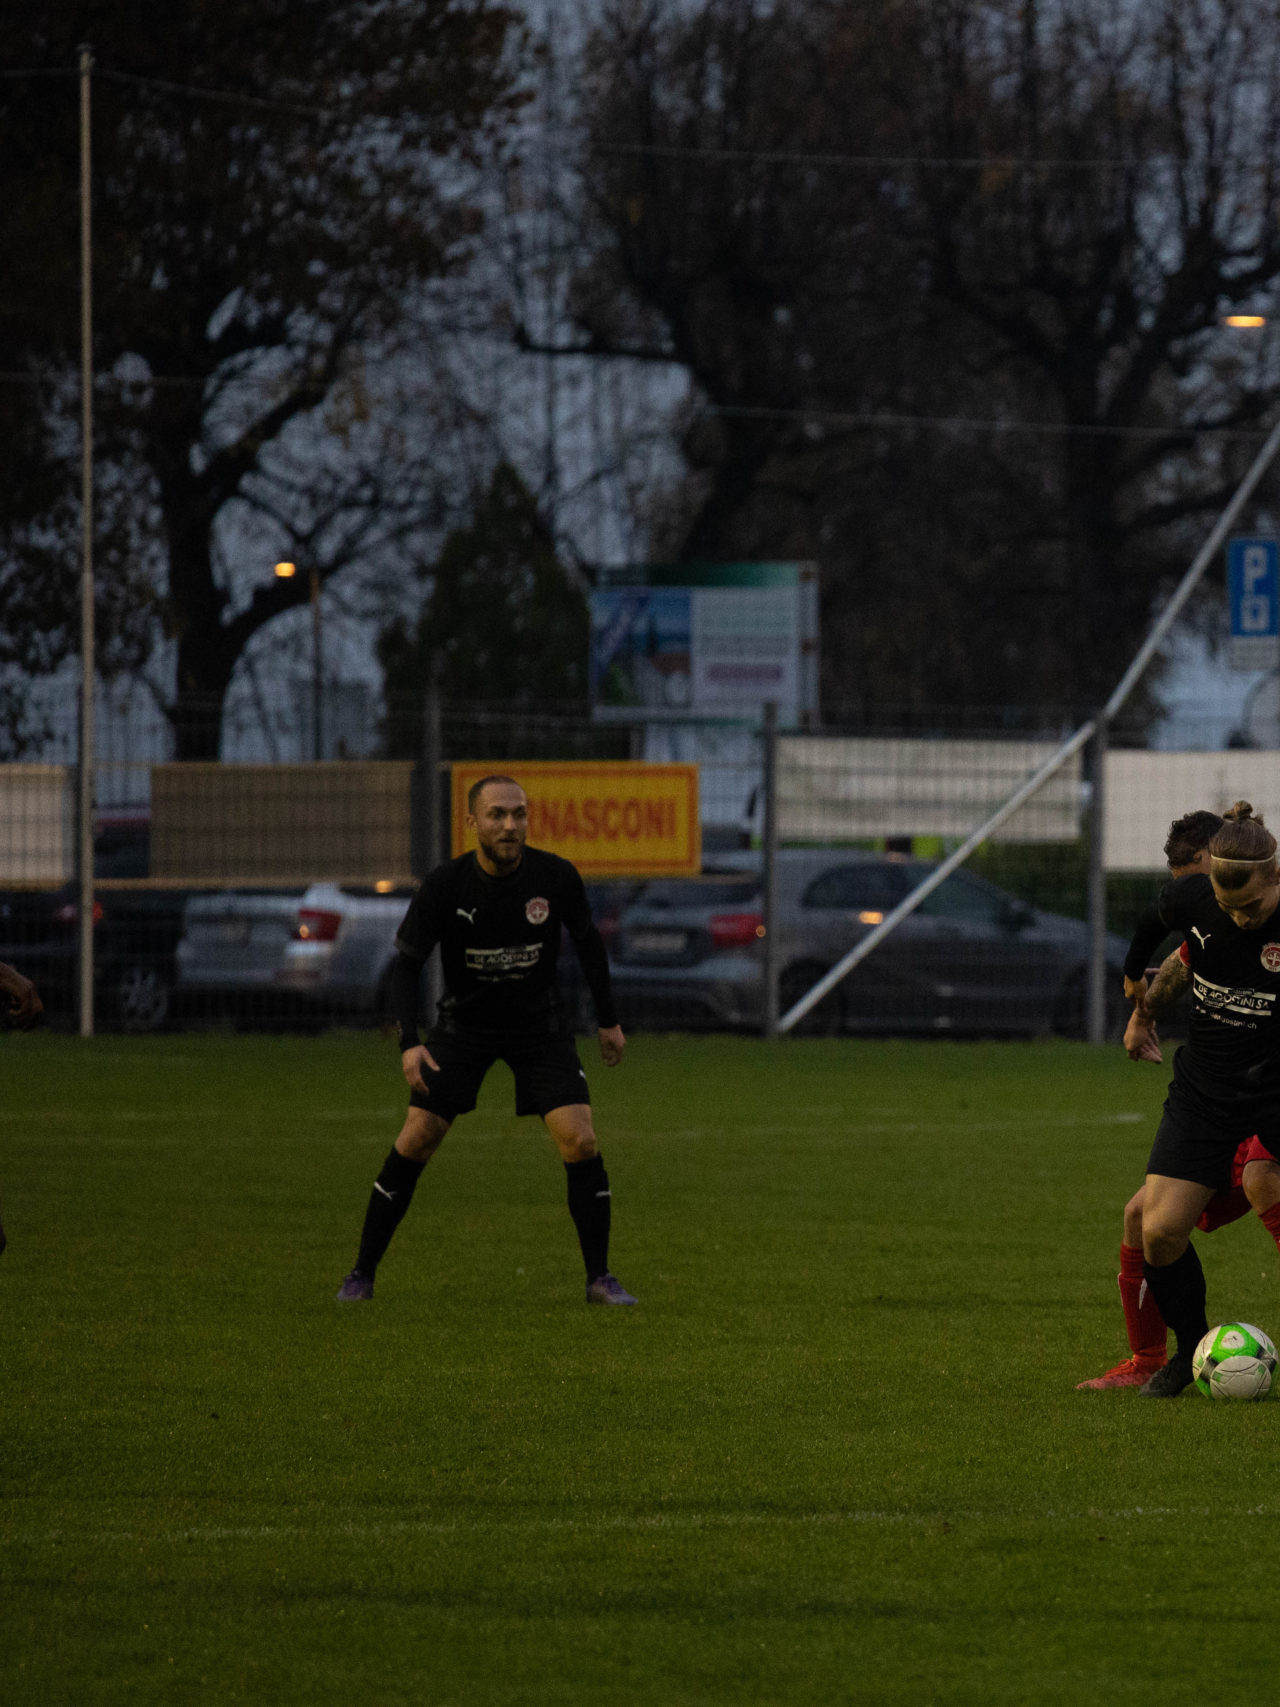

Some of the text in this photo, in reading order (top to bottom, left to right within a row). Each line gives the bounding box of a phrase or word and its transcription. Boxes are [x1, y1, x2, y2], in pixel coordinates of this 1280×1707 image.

[1241, 545, 1269, 594] P
[1198, 984, 1209, 996] DE
[1208, 992, 1255, 1008] AGOSTINI
[1255, 999, 1270, 1010] SA
